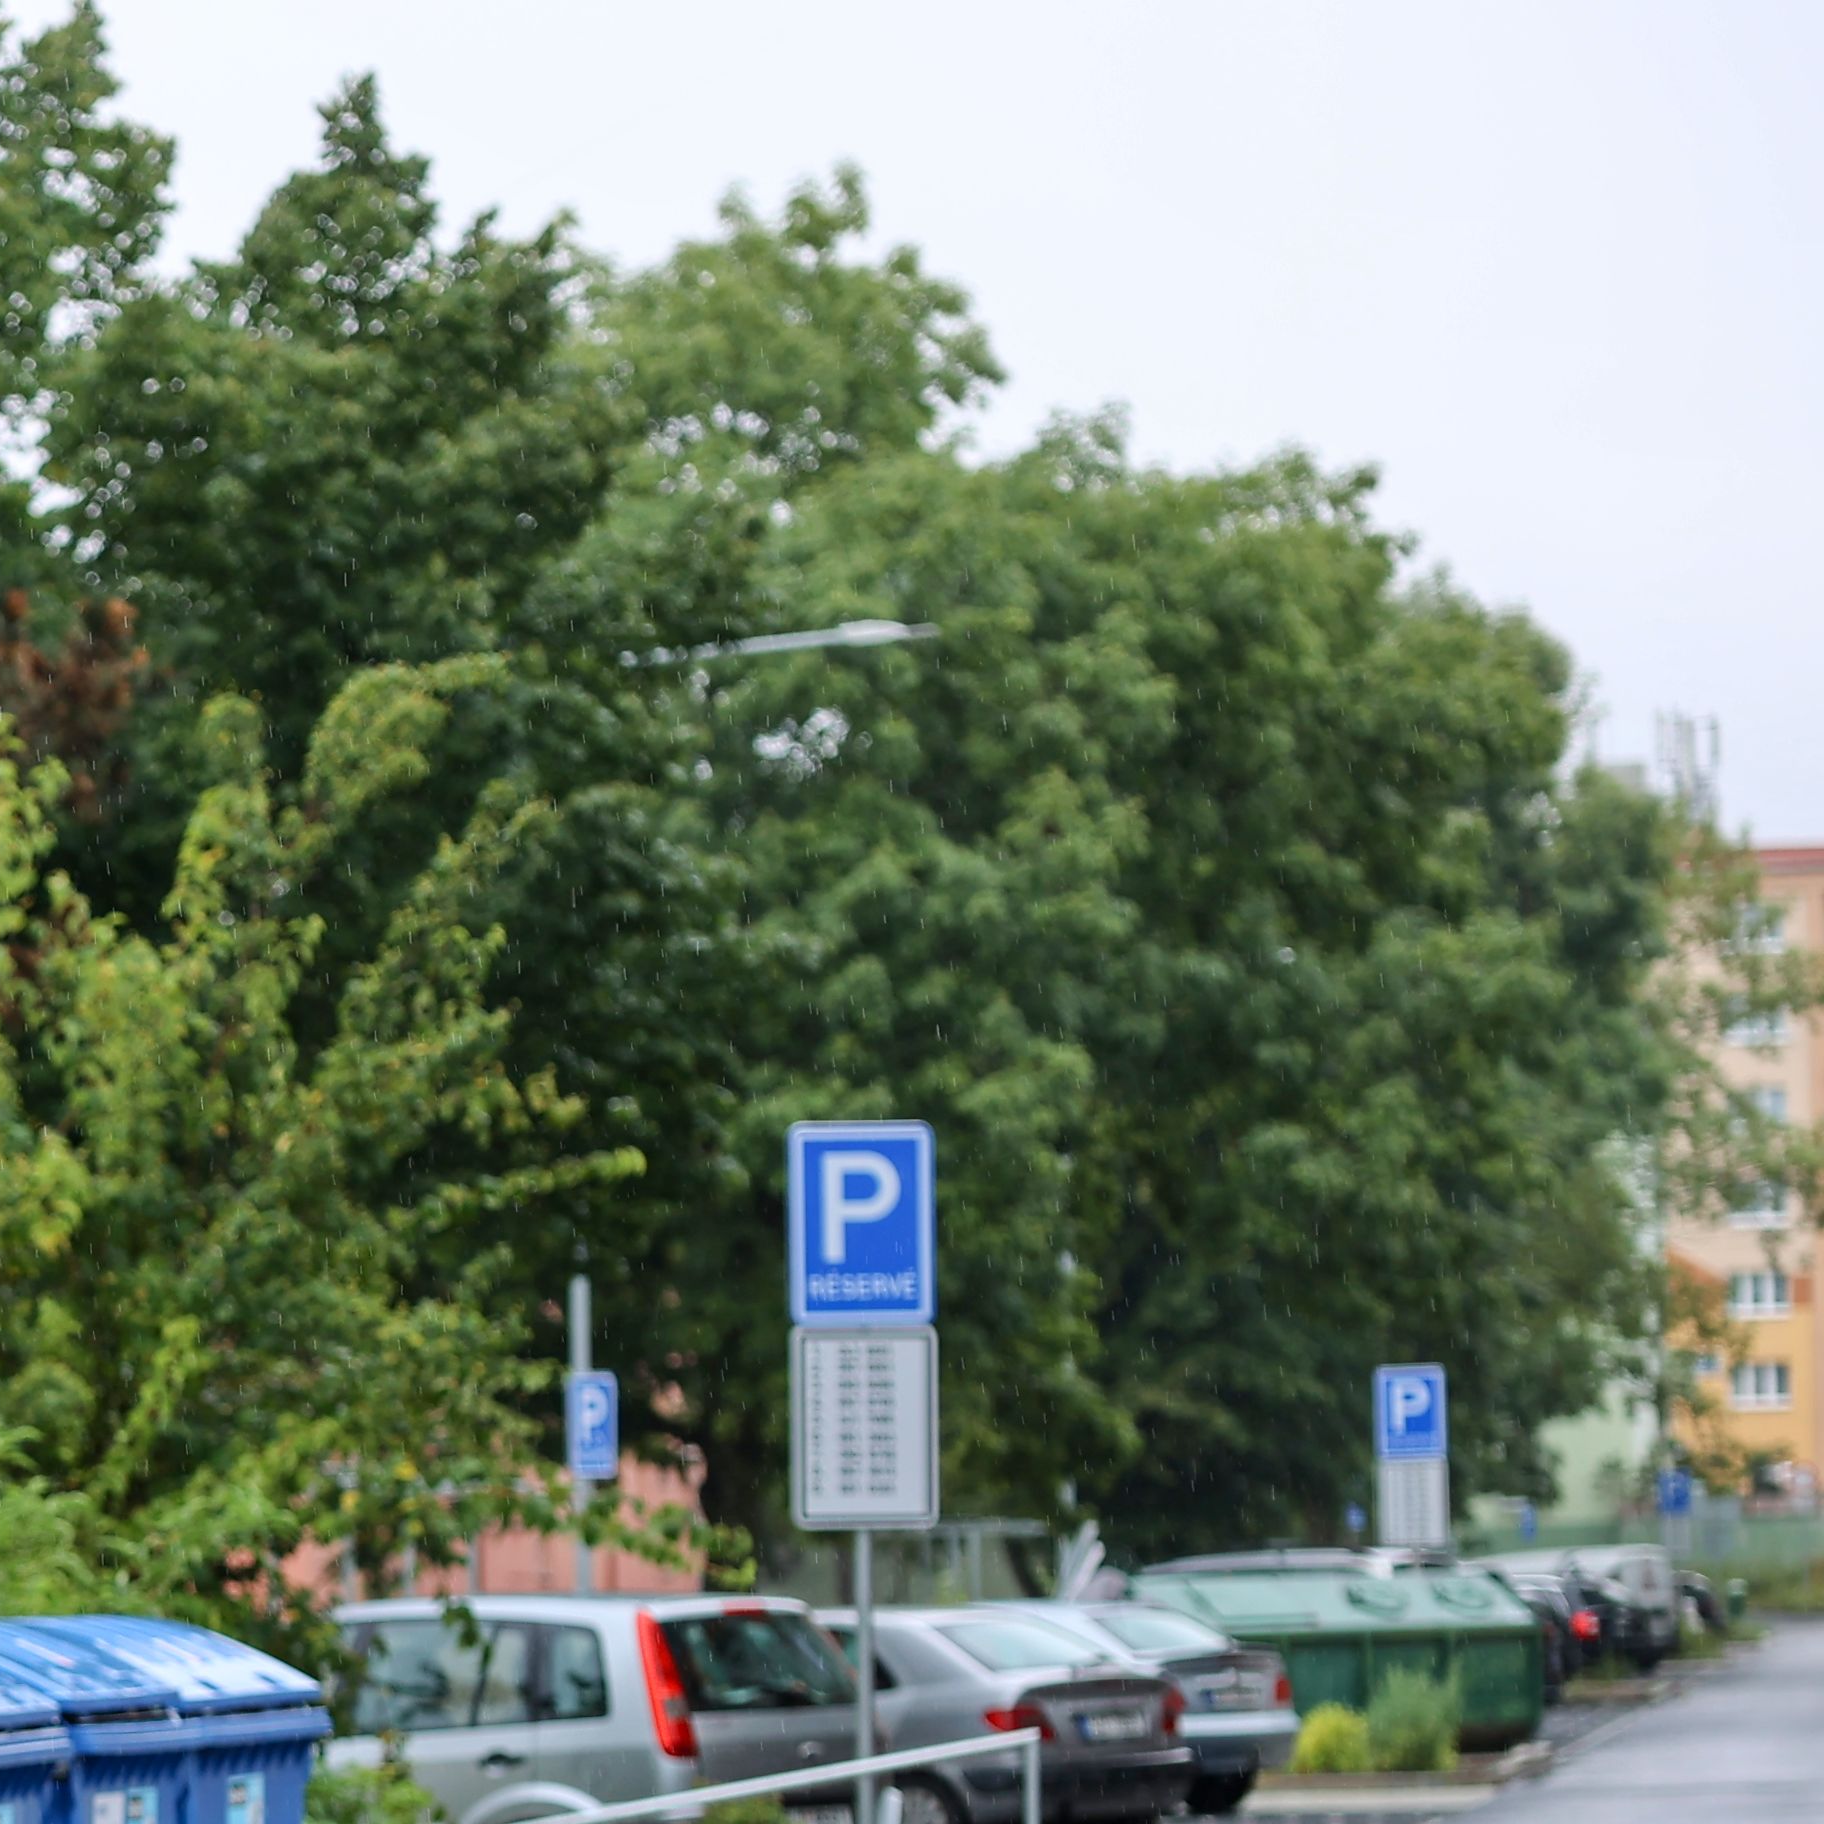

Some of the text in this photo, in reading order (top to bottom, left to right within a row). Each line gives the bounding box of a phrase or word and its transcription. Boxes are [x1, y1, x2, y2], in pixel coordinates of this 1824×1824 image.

[822, 1150, 902, 1266] P
[808, 1267, 918, 1301] RÉSERVÉ
[581, 1385, 609, 1442] P
[1390, 1376, 1431, 1436] P
